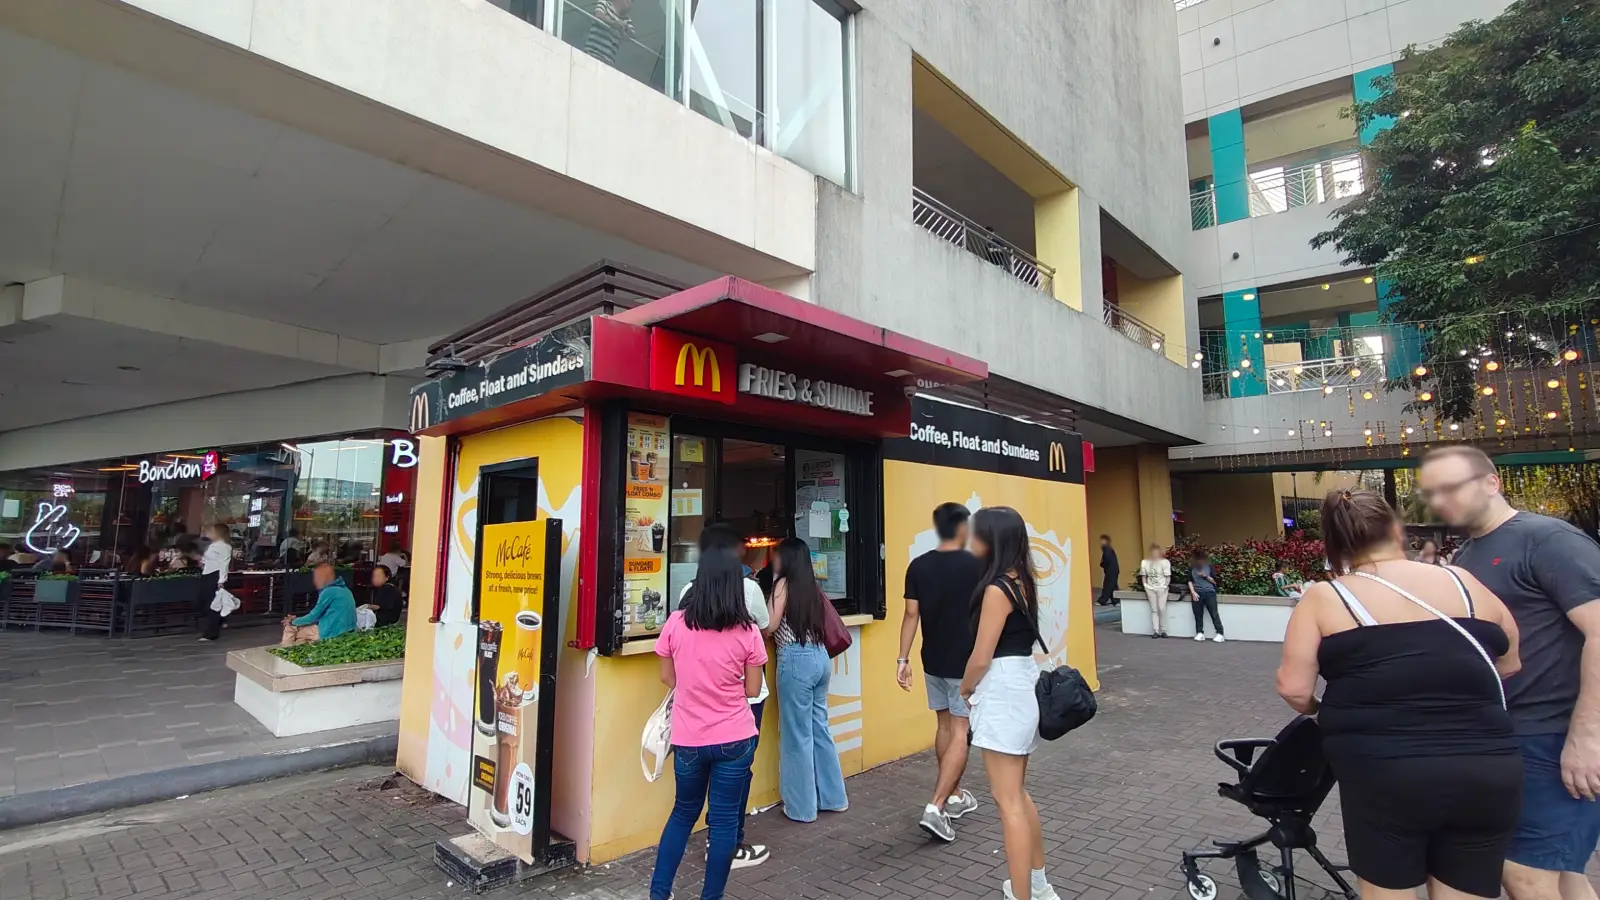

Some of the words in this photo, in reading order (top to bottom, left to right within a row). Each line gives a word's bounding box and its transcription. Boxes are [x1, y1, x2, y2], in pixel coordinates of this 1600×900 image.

[448, 387, 478, 409] Coffee,
[480, 374, 505, 398] Float
[506, 366, 527, 390] and
[528, 354, 584, 383] Sundaes
[739, 363, 796, 400] FRIES
[801, 379, 813, 402] &
[815, 380, 874, 416] SUNDAE
[391, 439, 420, 468] B
[910, 422, 951, 449] Coffee,
[952, 430, 980, 450] Float
[981, 439, 1000, 454] and
[1001, 440, 1040, 461] Sundaes
[139, 457, 200, 484] Bonchon
[496, 534, 532, 568] McCafé
[486, 570, 503, 581] Strong,
[504, 571, 526, 580] delicious
[527, 572, 542, 580] brews
[498, 584, 512, 594] fresh,
[524, 586, 538, 595] price!
[516, 782, 531, 817] 59
[515, 816, 527, 828] EACH
